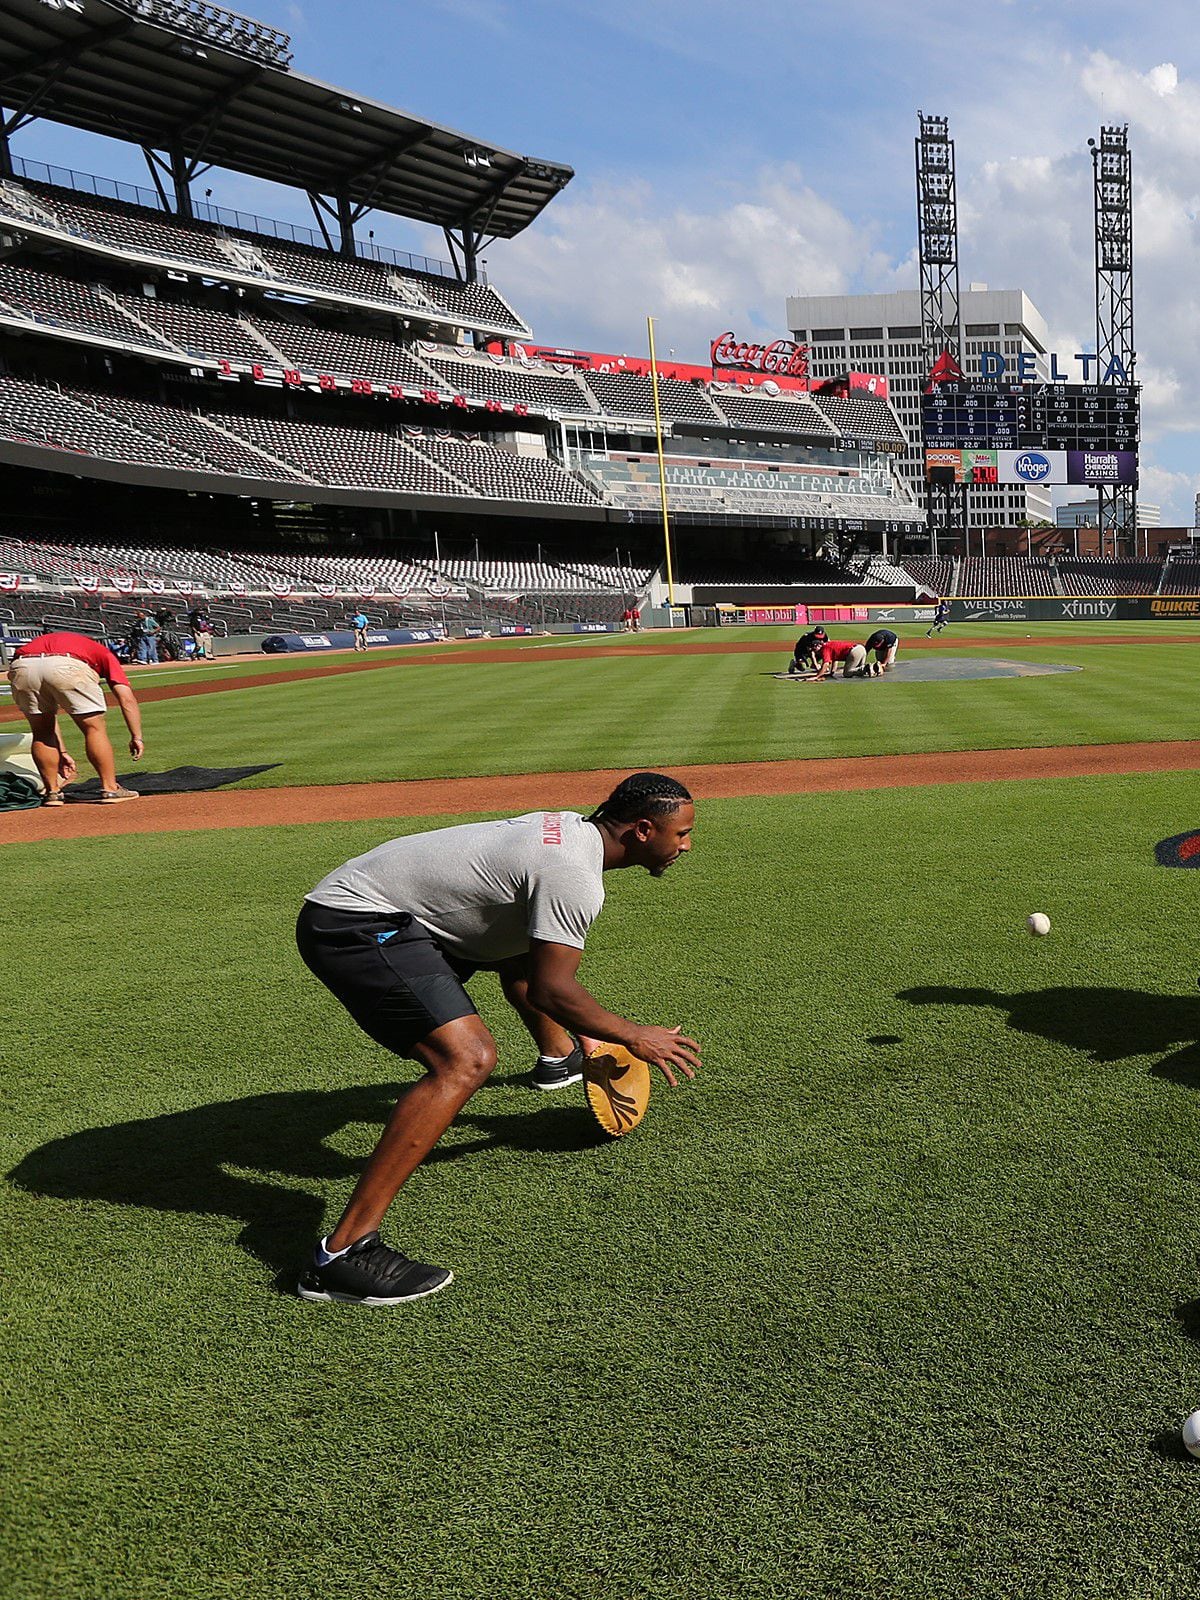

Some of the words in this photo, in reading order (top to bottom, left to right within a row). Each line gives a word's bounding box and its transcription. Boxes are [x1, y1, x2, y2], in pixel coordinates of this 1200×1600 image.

[711, 331, 812, 375] Coca-Cola
[218, 359, 230, 374] 3
[252, 364, 264, 380] 6
[980, 351, 1129, 382] DELTA
[284, 370, 302, 385] 10
[319, 375, 337, 390] 21
[351, 379, 373, 395] 29
[947, 383, 959, 393] 13
[970, 382, 999, 393] ACUÑA
[1054, 385, 1066, 395] 99
[1082, 386, 1098, 395] RYU
[421, 389, 439, 404] 35
[840, 439, 856, 448] 3:51
[1084, 453, 1118, 464] Harrah's
[1018, 456, 1048, 478] Kroger
[665, 467, 716, 486] HANK
[720, 471, 790, 489] AARON
[790, 518, 797, 528] R
[810, 519, 816, 529] H
[828, 520, 834, 529] E
[892, 523, 898, 532] 0
[905, 524, 910, 532] 0
[1061, 600, 1116, 618] xfinity
